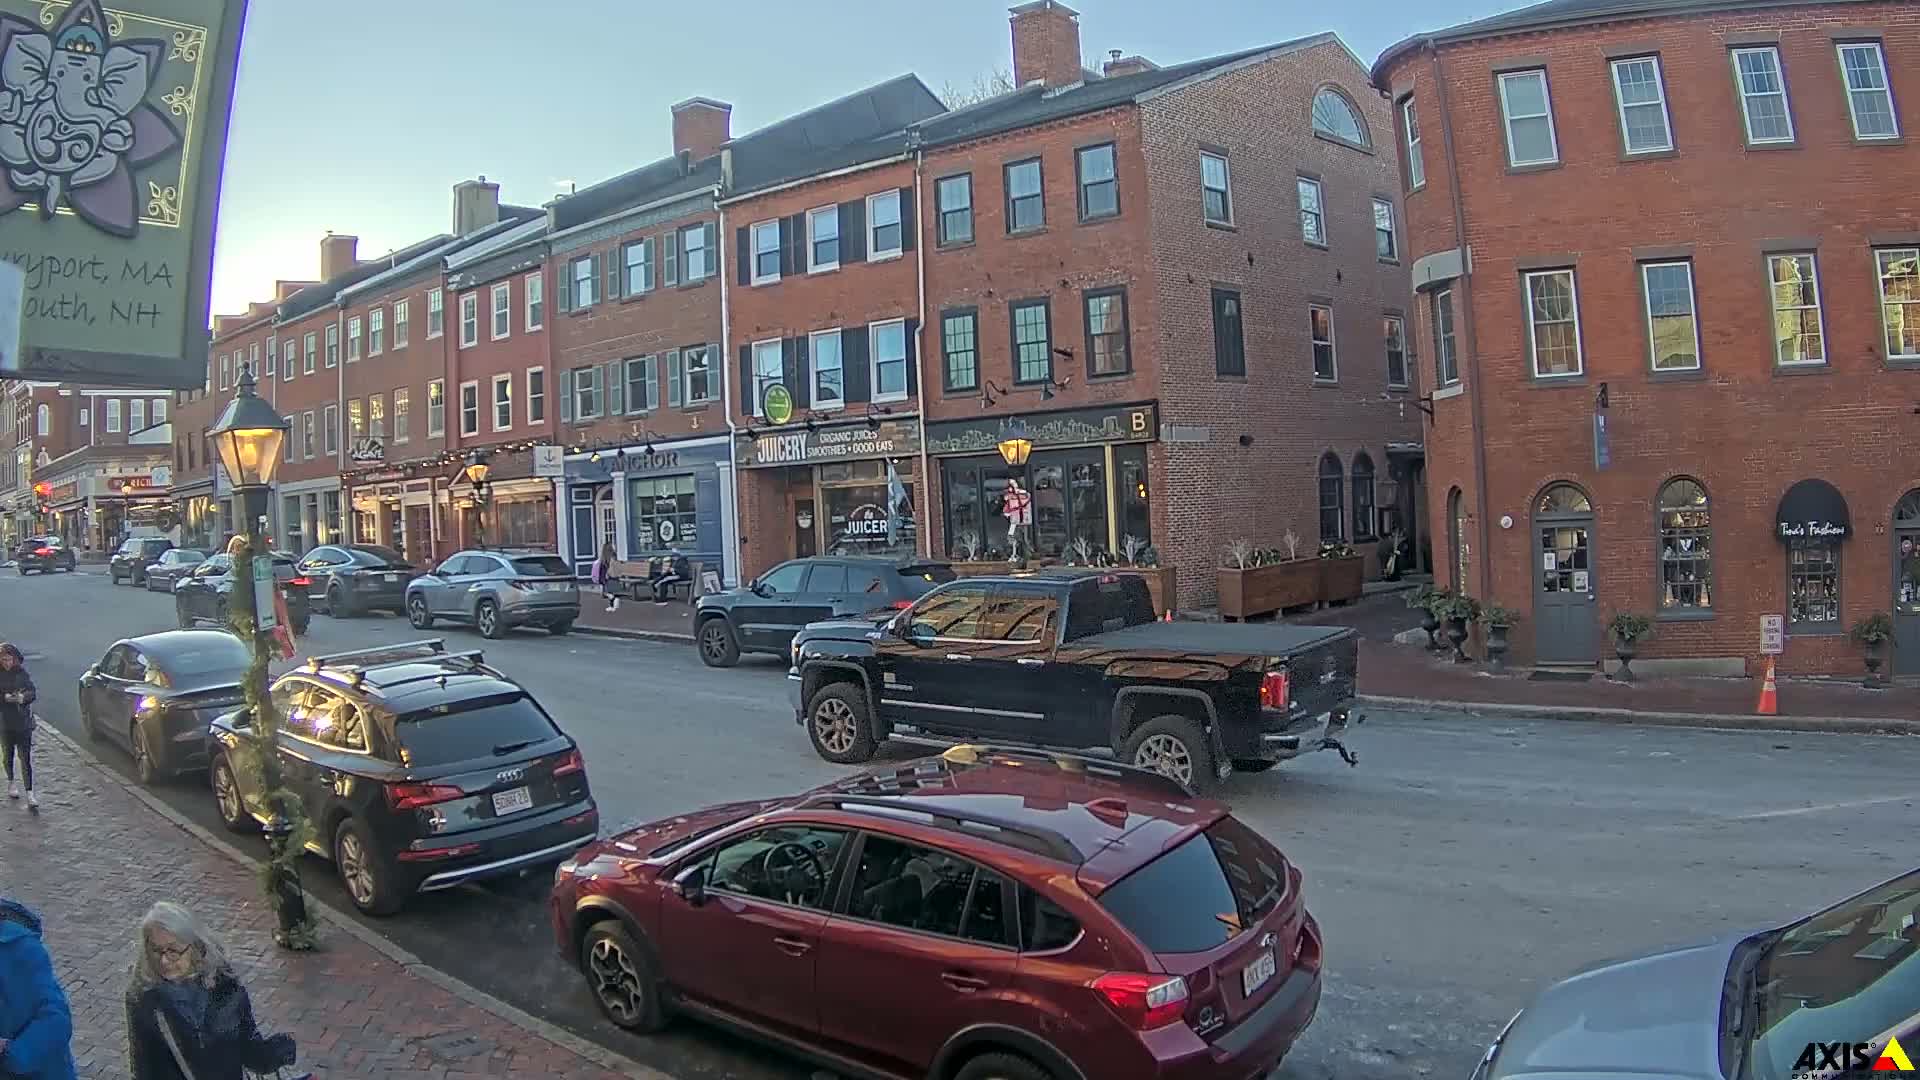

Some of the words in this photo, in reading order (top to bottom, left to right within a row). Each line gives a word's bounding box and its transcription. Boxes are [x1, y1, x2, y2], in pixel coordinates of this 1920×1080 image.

[121, 258, 174, 288] MA
[110, 300, 161, 328] NH
[1132, 412, 1145, 431] B
[852, 429, 878, 441] JUICES
[757, 434, 808, 463] JUICERY
[807, 444, 847, 458] SMOOTHIES
[852, 442, 875, 454] GOOD
[876, 440, 894, 452] EATS
[844, 519, 890, 534] JUICER
